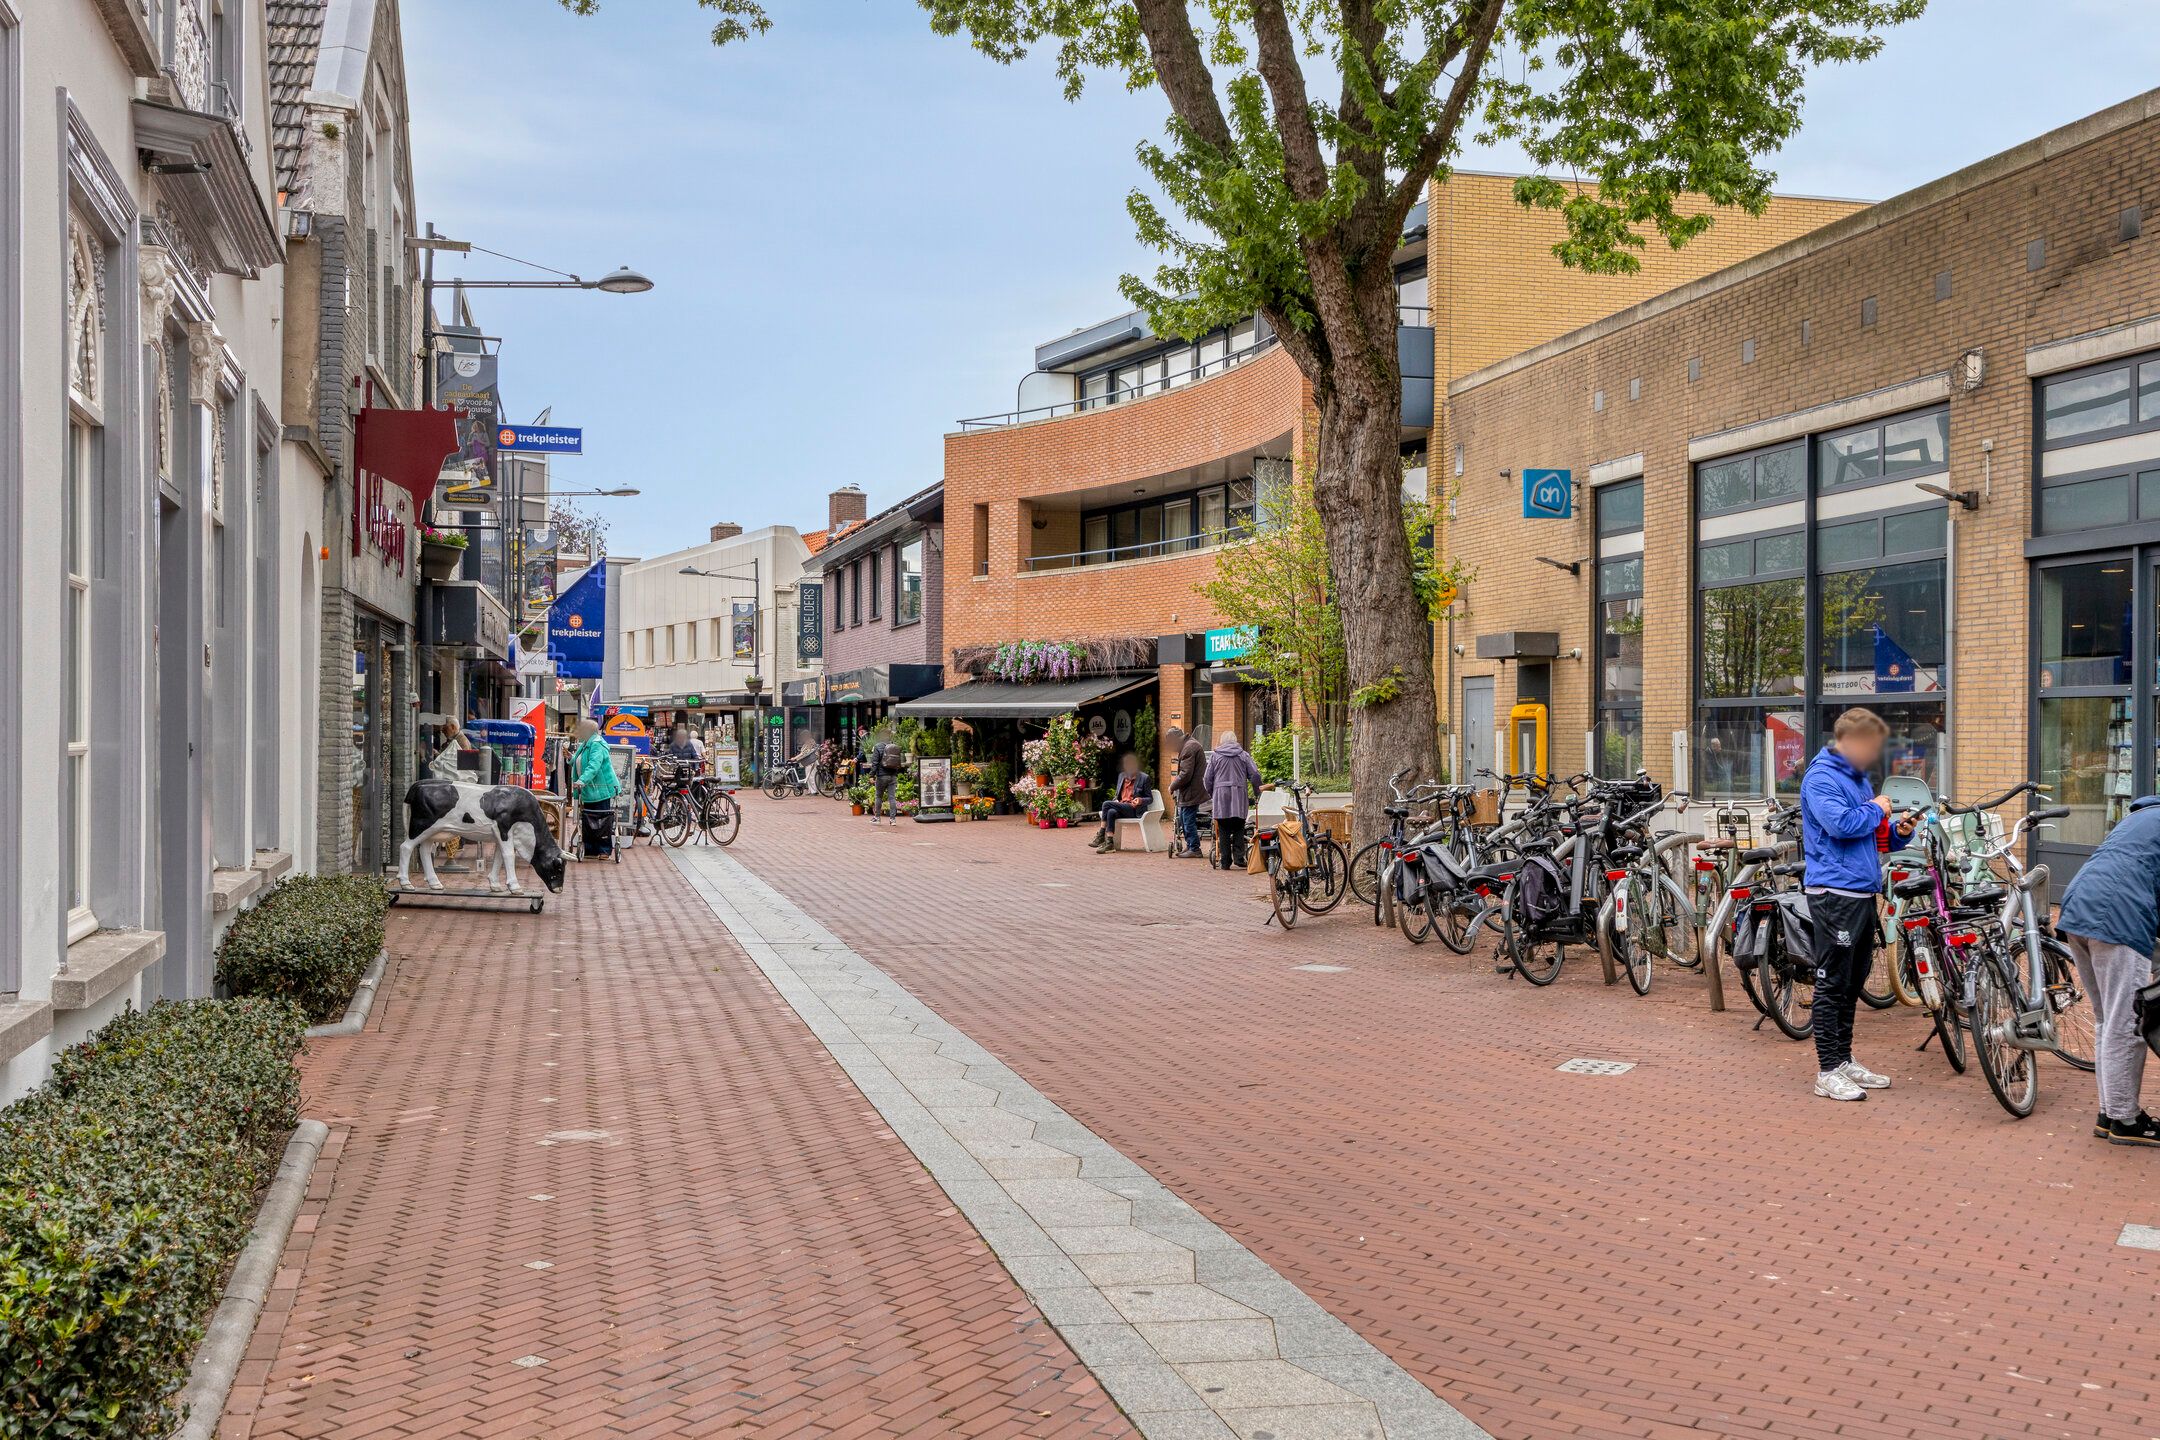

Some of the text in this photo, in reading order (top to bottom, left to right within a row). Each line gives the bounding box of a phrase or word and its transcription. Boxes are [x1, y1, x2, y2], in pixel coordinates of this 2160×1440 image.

[442, 404, 492, 414] Oterhoutse
[518, 433, 580, 445] trekpleister
[803, 588, 815, 634] SNELDERS
[551, 629, 602, 638] trekpleister
[770, 728, 780, 769] roeders
